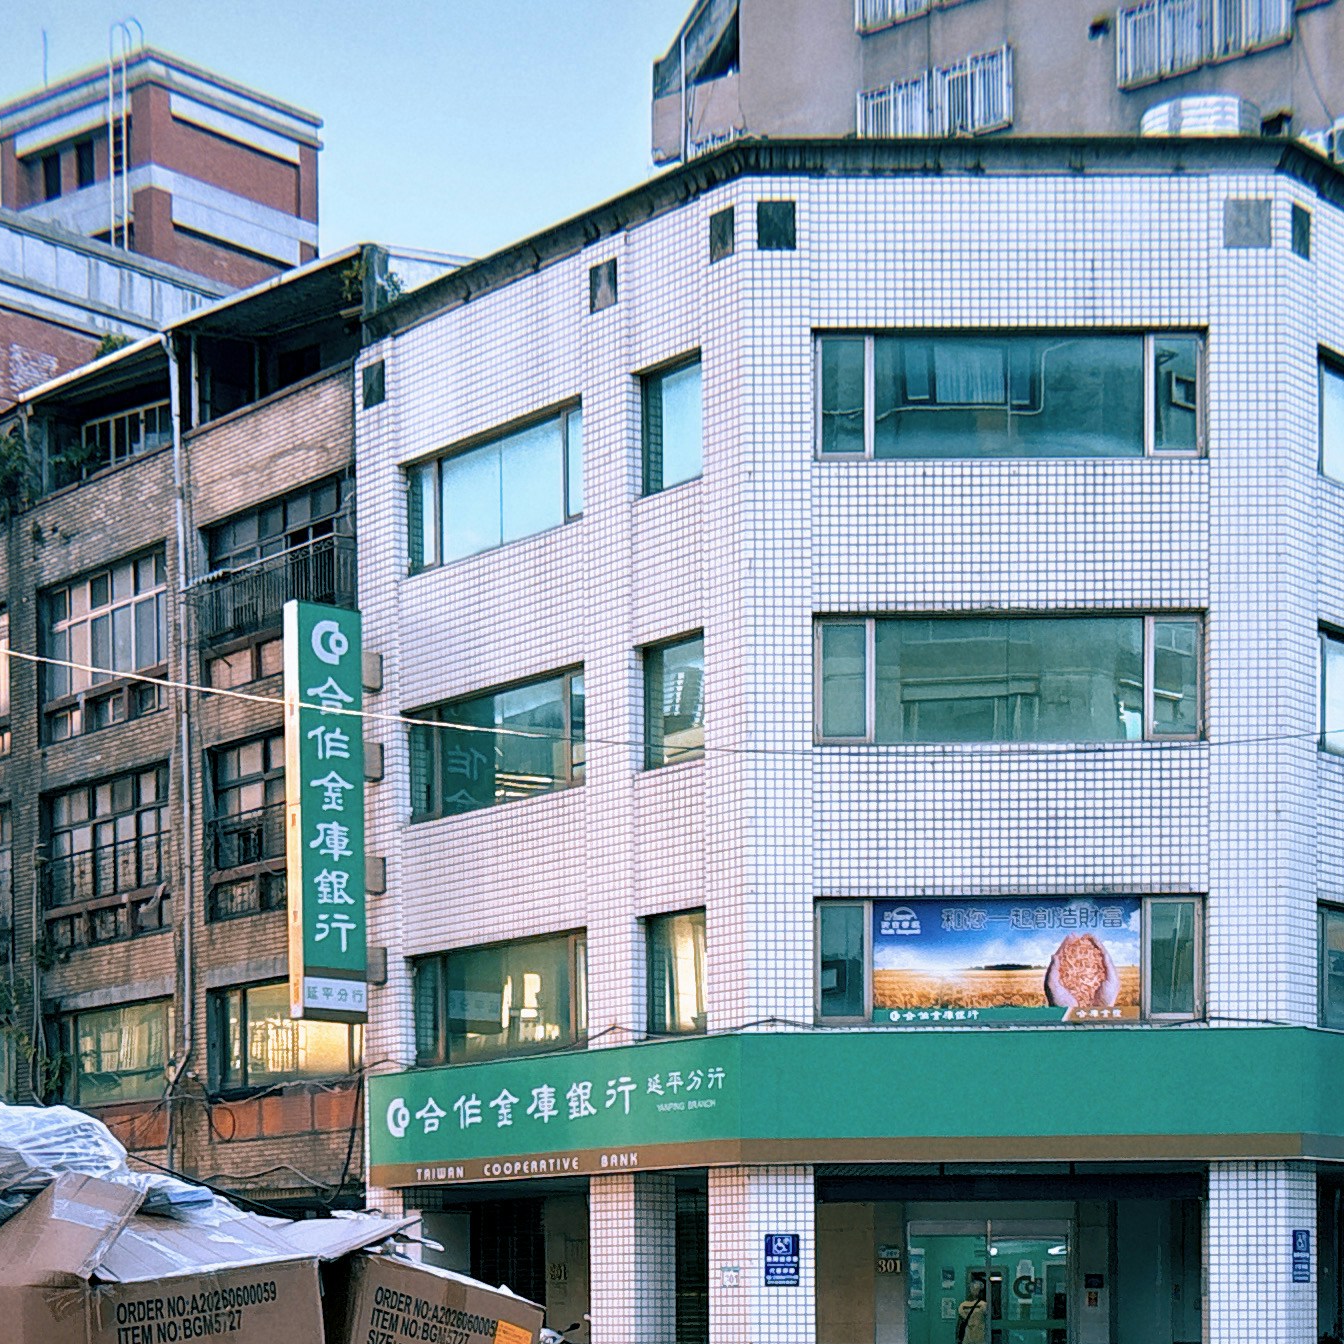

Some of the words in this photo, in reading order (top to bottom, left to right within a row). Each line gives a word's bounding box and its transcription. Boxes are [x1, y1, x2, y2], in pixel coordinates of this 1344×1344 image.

[307, 677, 357, 954] 合作金庫銀行
[940, 906, 1124, 931] 和您一起創造財富
[305, 984, 365, 1004] 延平分行
[415, 1076, 638, 1134] 合作金庫銀行
[647, 1066, 726, 1096] 延平分行
[416, 1166, 464, 1181] TAIWAN
[483, 1156, 579, 1177] COOPERATIVE
[601, 1152, 638, 1169] BANK
[877, 1259, 902, 1274] 301
[116, 1298, 164, 1325] ORDER
[374, 1286, 410, 1316] ORDER
[157, 1309, 242, 1344] NO:BGM5727
[370, 1307, 398, 1332] ITEM
